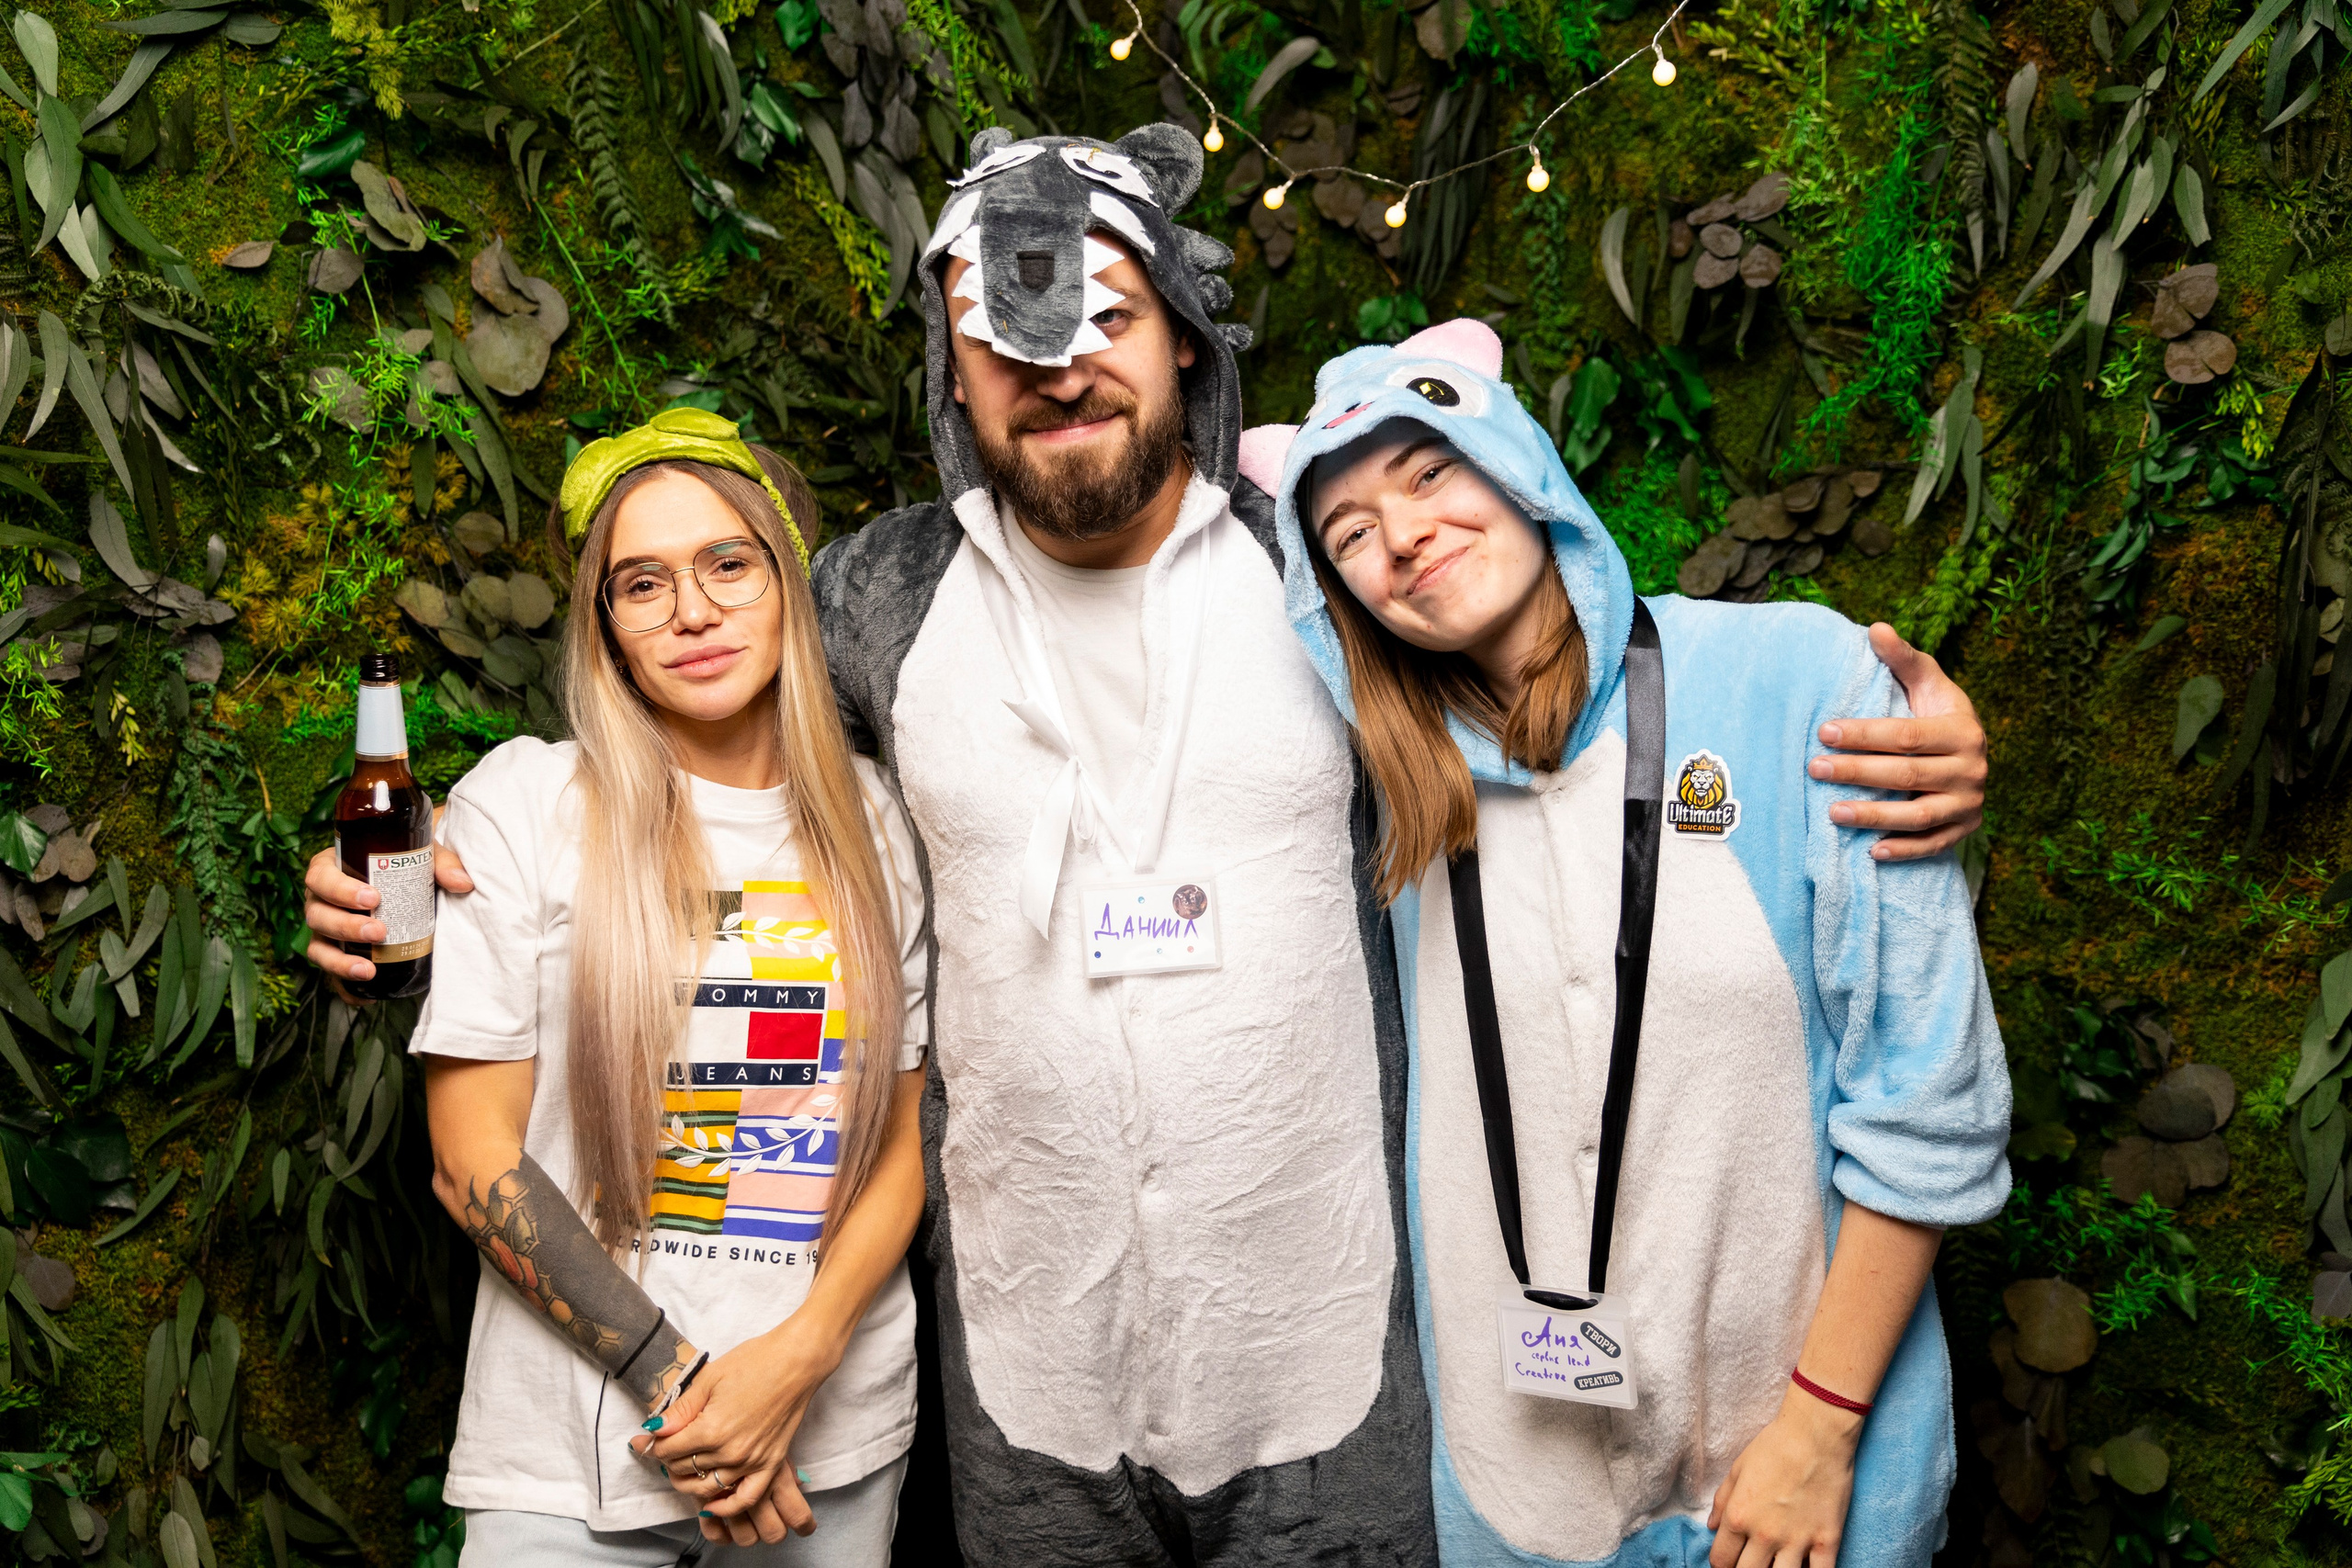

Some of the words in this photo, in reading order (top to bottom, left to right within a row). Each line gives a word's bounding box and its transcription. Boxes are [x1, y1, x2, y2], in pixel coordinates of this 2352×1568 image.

[1678, 824, 1722, 832] EDUCATION
[683, 984, 819, 1005] OMMY
[729, 1247, 797, 1265] SINCE
[807, 1250, 818, 1264] 19
[1585, 1325, 1618, 1356] ТВОРИ
[1567, 1354, 1590, 1367] lead
[1515, 1361, 1566, 1382] Creative
[1577, 1373, 1621, 1389] КРЕАТИВЬ
